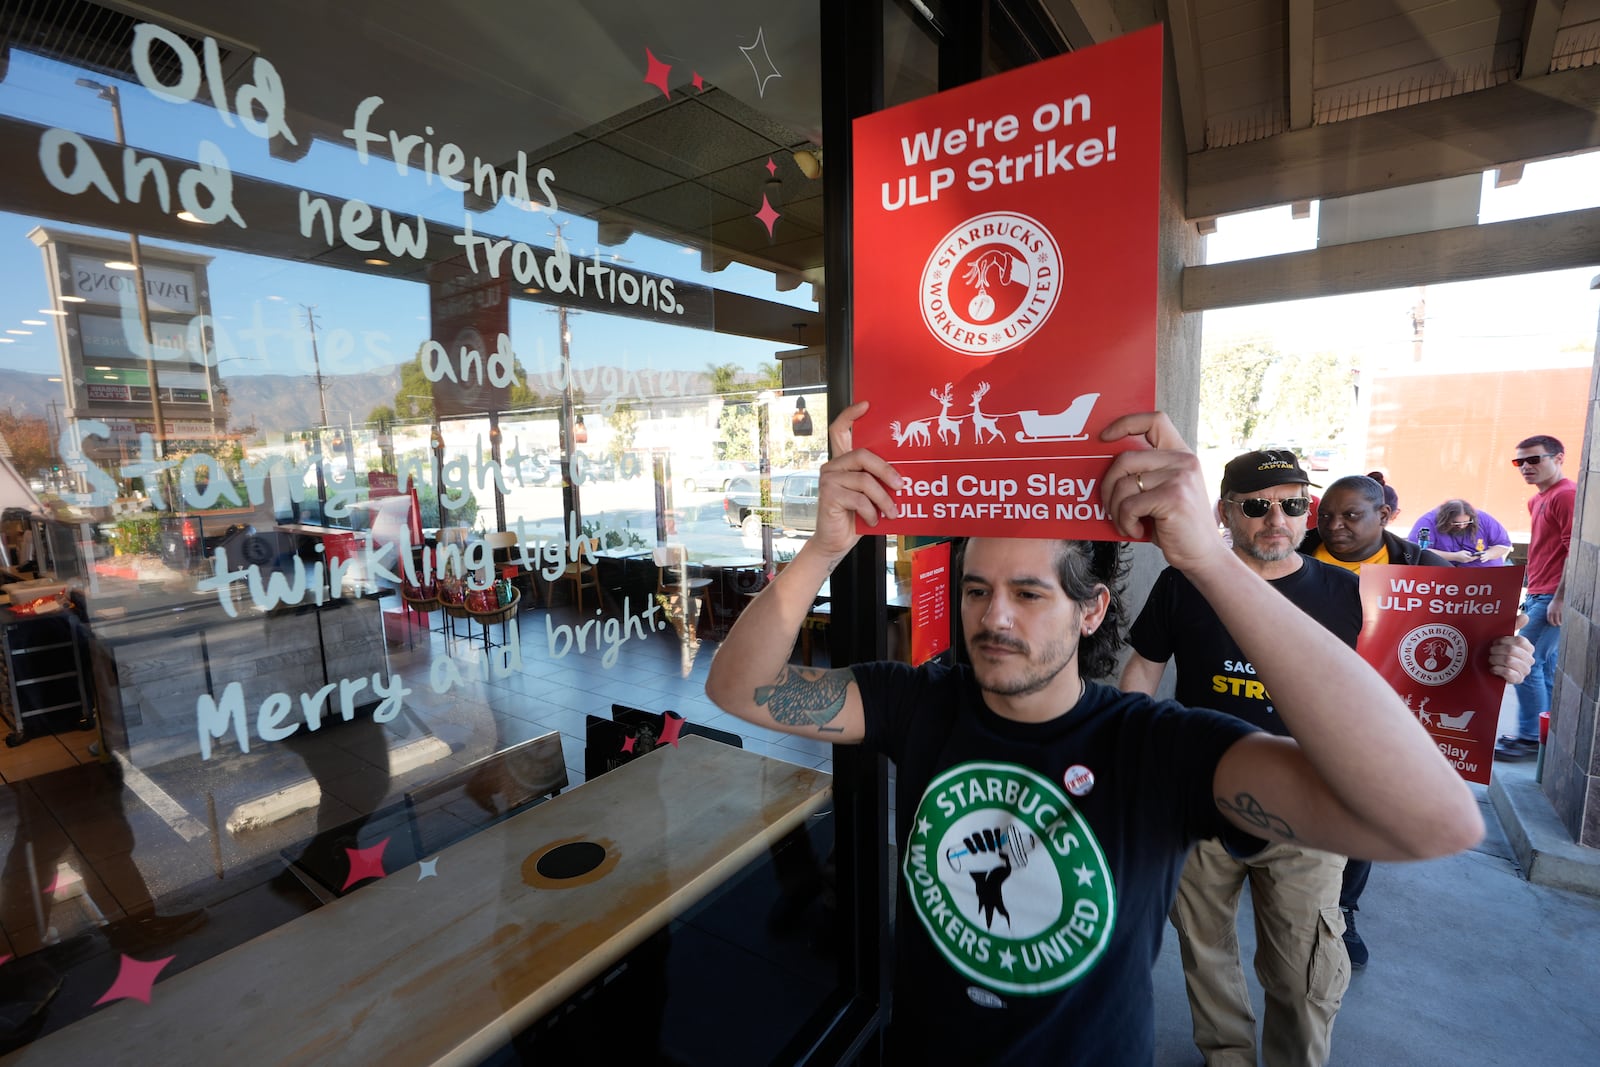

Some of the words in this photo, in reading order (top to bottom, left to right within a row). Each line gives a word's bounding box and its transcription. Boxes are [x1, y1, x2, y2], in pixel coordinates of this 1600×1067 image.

[131, 22, 297, 145] Old
[343, 95, 558, 214] friends
[900, 112, 1020, 167] We're
[1033, 93, 1091, 134] on
[881, 167, 956, 213] ULP
[967, 126, 1117, 193] Strike!
[39, 127, 247, 228] and
[300, 189, 428, 261] new
[454, 212, 685, 315] traditions.
[937, 221, 1045, 270] STARBUCKS
[118, 277, 399, 377] Lattes
[421, 332, 519, 391] and
[931, 280, 988, 347] WORKERS
[1004, 265, 1052, 341] UNITED
[58, 418, 368, 518] Starry
[398, 433, 551, 510] nights
[896, 475, 948, 497] Red
[956, 474, 1018, 502] Cup
[1027, 473, 1096, 502] Slay
[881, 503, 928, 519] ULL
[933, 503, 1049, 520] STAFFING
[197, 525, 496, 620] twinkling
[516, 510, 641, 581] lights.
[1390, 578, 1459, 597] We're
[1465, 582, 1492, 596] on
[1376, 595, 1422, 612] ULP
[1429, 598, 1501, 615] Strike!
[1410, 627, 1463, 646] STARBUCKS
[196, 667, 411, 760] Merry
[430, 618, 522, 694] and
[545, 592, 667, 670] bright.
[1212, 674, 1272, 701] STR
[1403, 646, 1433, 682] WORKERS
[1439, 652, 1463, 682] UNITED
[1438, 742, 1469, 761] Slay
[936, 777, 1080, 857] STARBUCKS
[910, 843, 992, 963] WORKERS
[1021, 898, 1099, 972] UNITED
